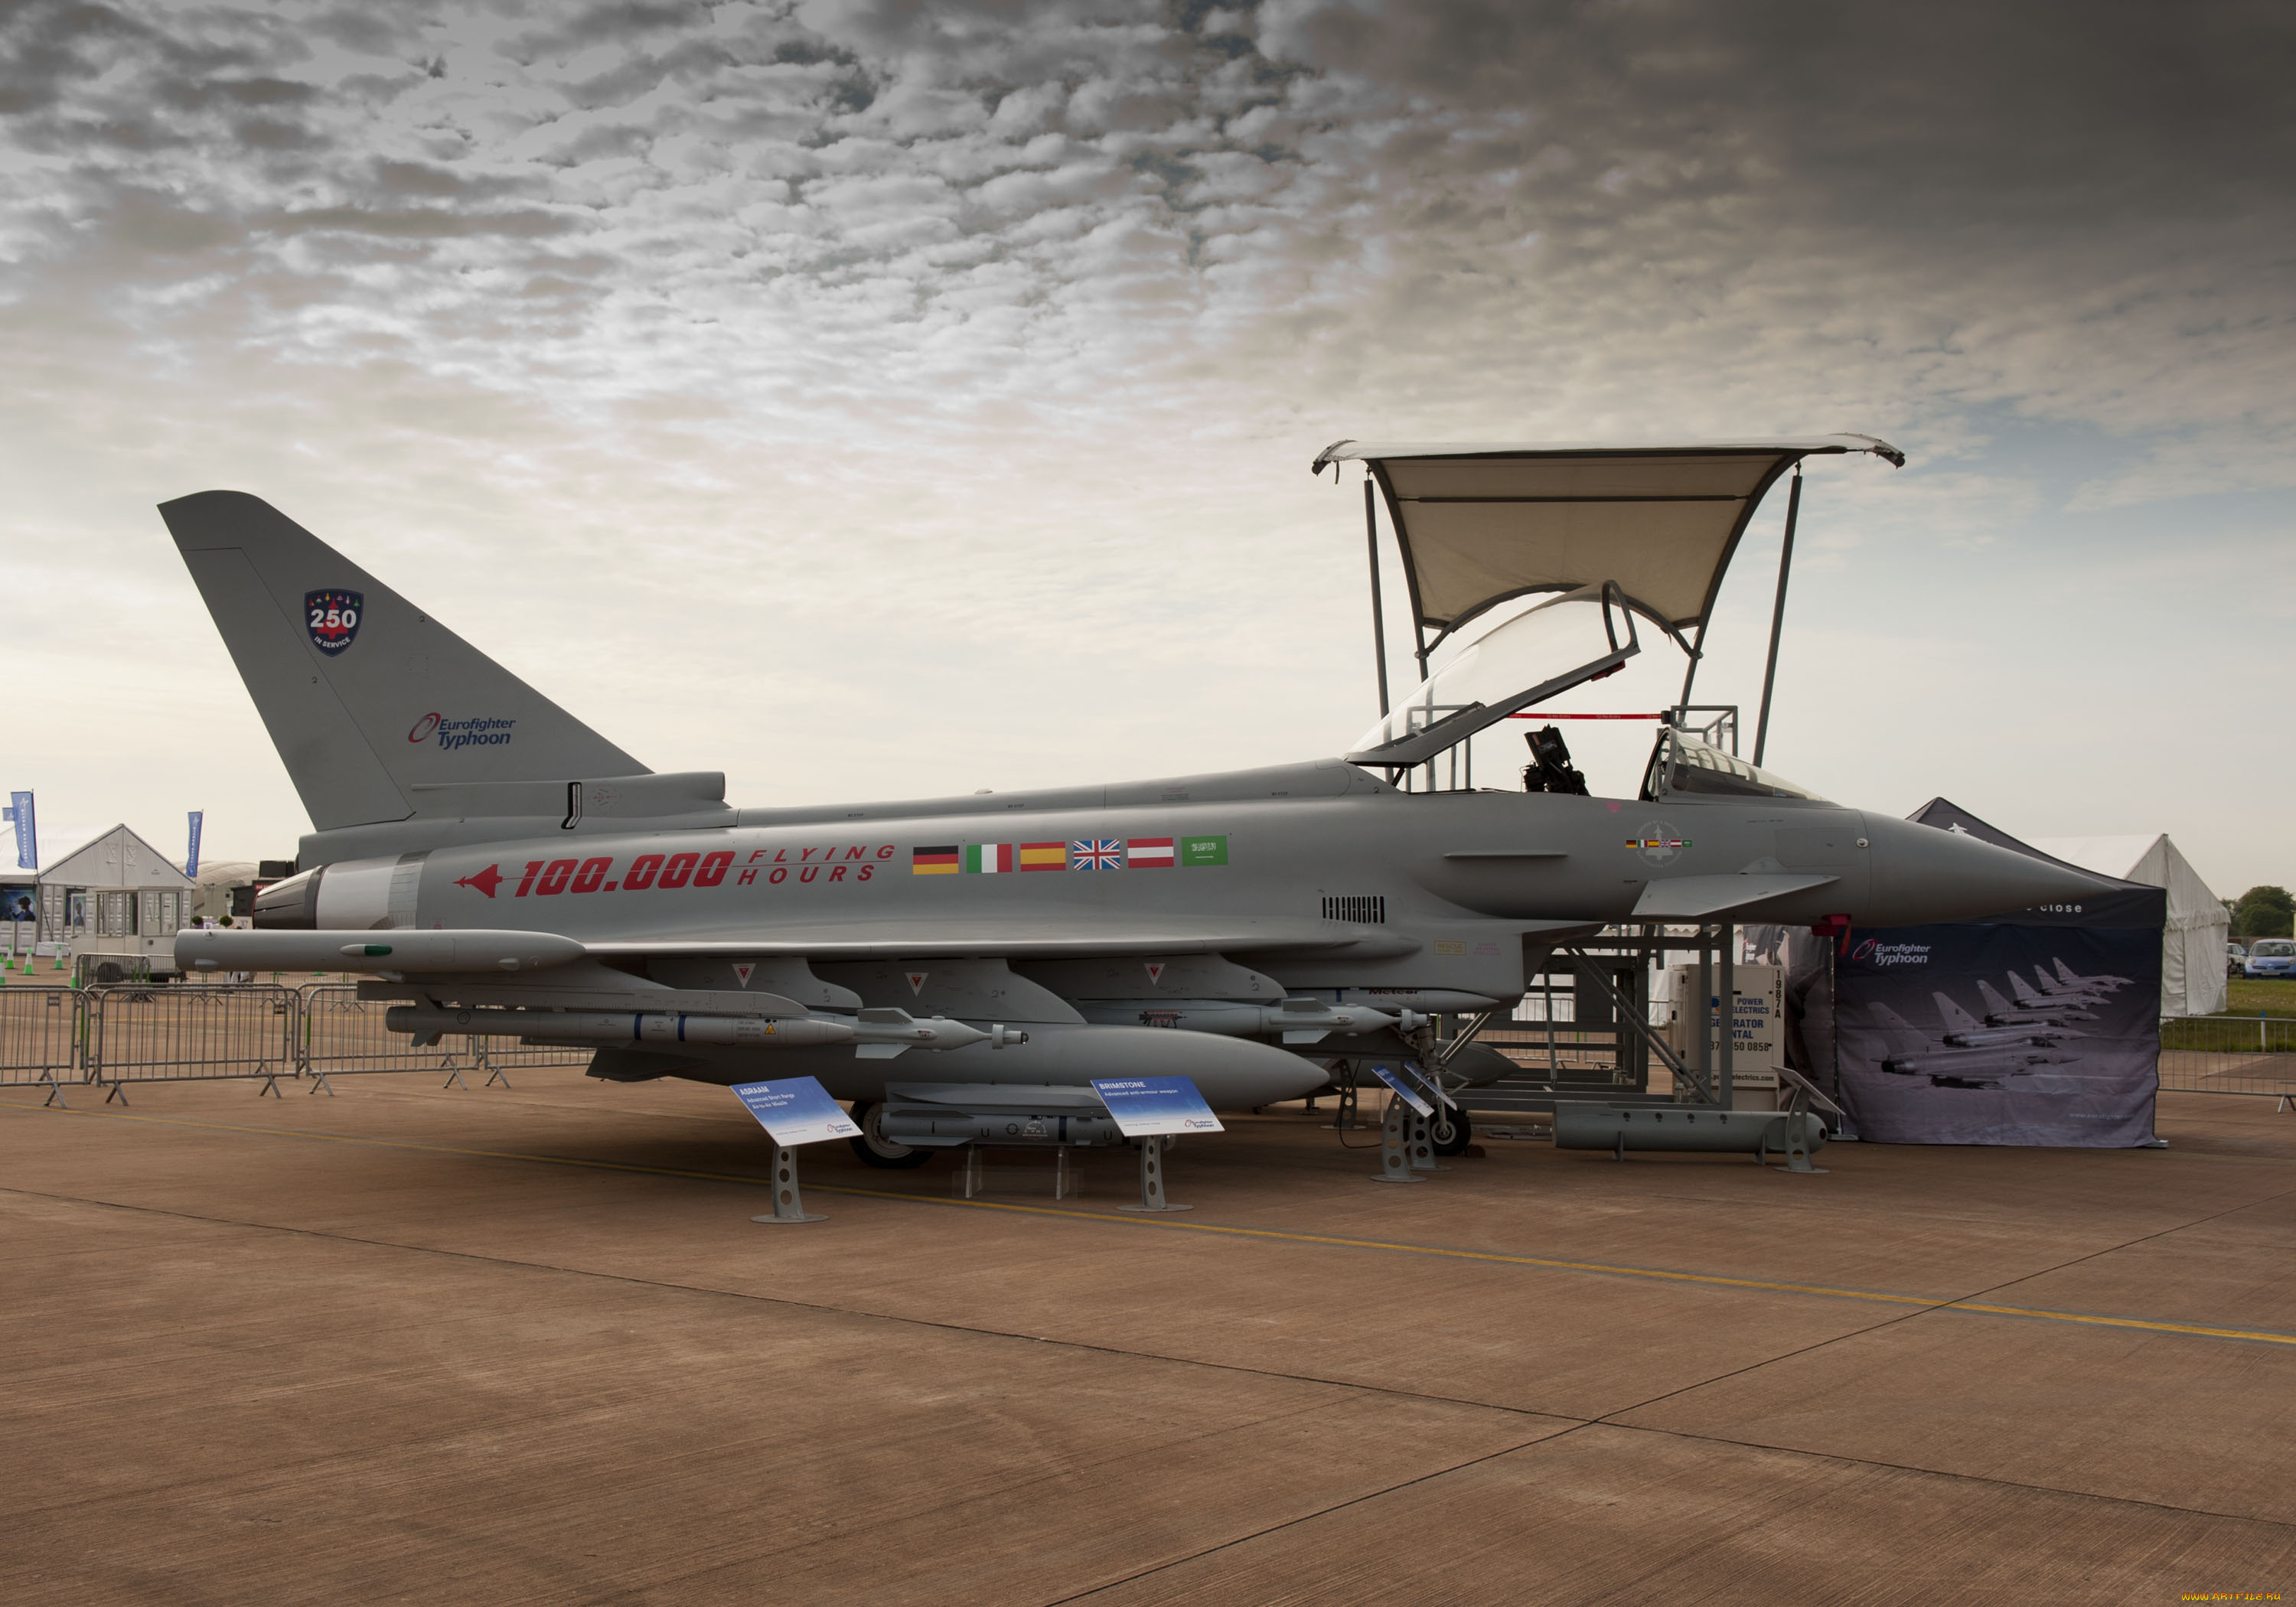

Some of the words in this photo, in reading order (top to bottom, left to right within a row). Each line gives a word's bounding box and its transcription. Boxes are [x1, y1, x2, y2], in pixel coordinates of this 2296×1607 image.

[310, 609, 357, 628] 250
[314, 636, 322, 644] IN
[322, 636, 351, 648] SERVICE
[439, 717, 517, 732] Eurofighter
[438, 731, 511, 750] Typhoon
[748, 844, 896, 863] FLYING
[514, 850, 736, 898] 100.000
[736, 864, 876, 885] HOURS
[2040, 904, 2082, 912] close
[1875, 944, 1931, 953] Eurofighter
[1874, 953, 1928, 966] Typhoon
[1711, 1019, 1763, 1028] GERATOR
[1733, 1030, 1753, 1039] NTAL
[1747, 1042, 1769, 1052] 0858
[739, 1085, 770, 1095] ASRAAM
[1098, 1081, 1146, 1090] BRIMSTONE
